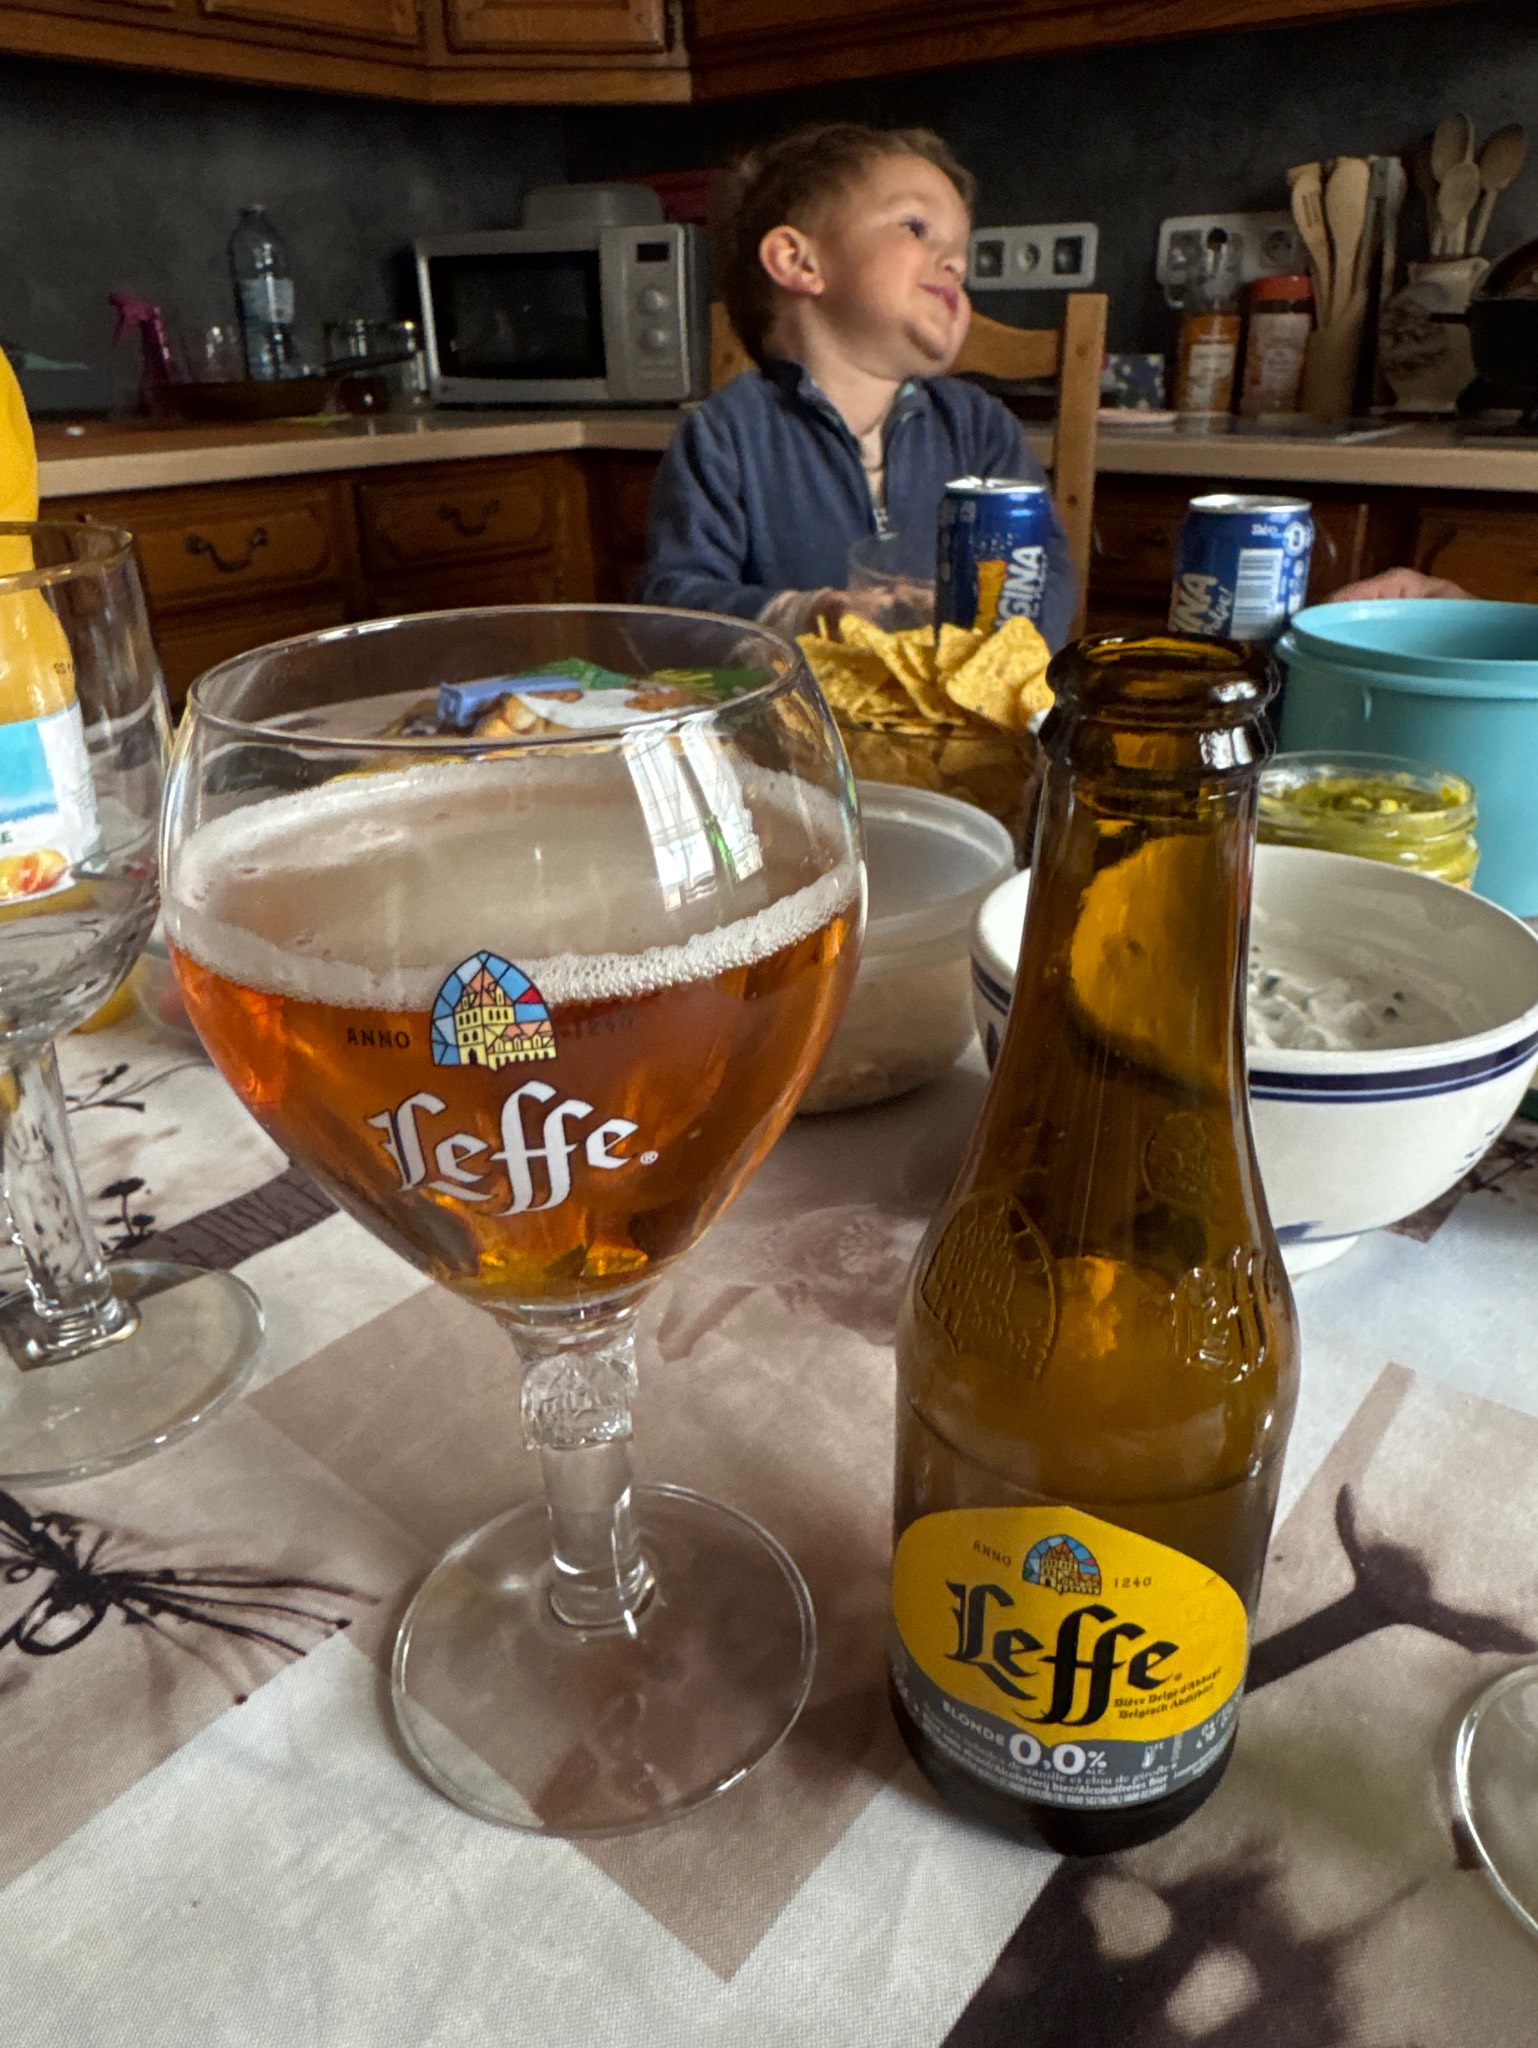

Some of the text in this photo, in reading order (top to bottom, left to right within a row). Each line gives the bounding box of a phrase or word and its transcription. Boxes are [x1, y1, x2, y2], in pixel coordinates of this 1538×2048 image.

[997, 546, 1044, 626] GINA
[1169, 573, 1219, 636] INA
[346, 1027, 411, 1050] ANNO
[367, 1080, 639, 1217] Leffe
[973, 1539, 1013, 1567] ANNO
[1113, 1576, 1153, 1590] 1240
[944, 1579, 1180, 1727] Leffe
[943, 1700, 1006, 1747] BLONDE
